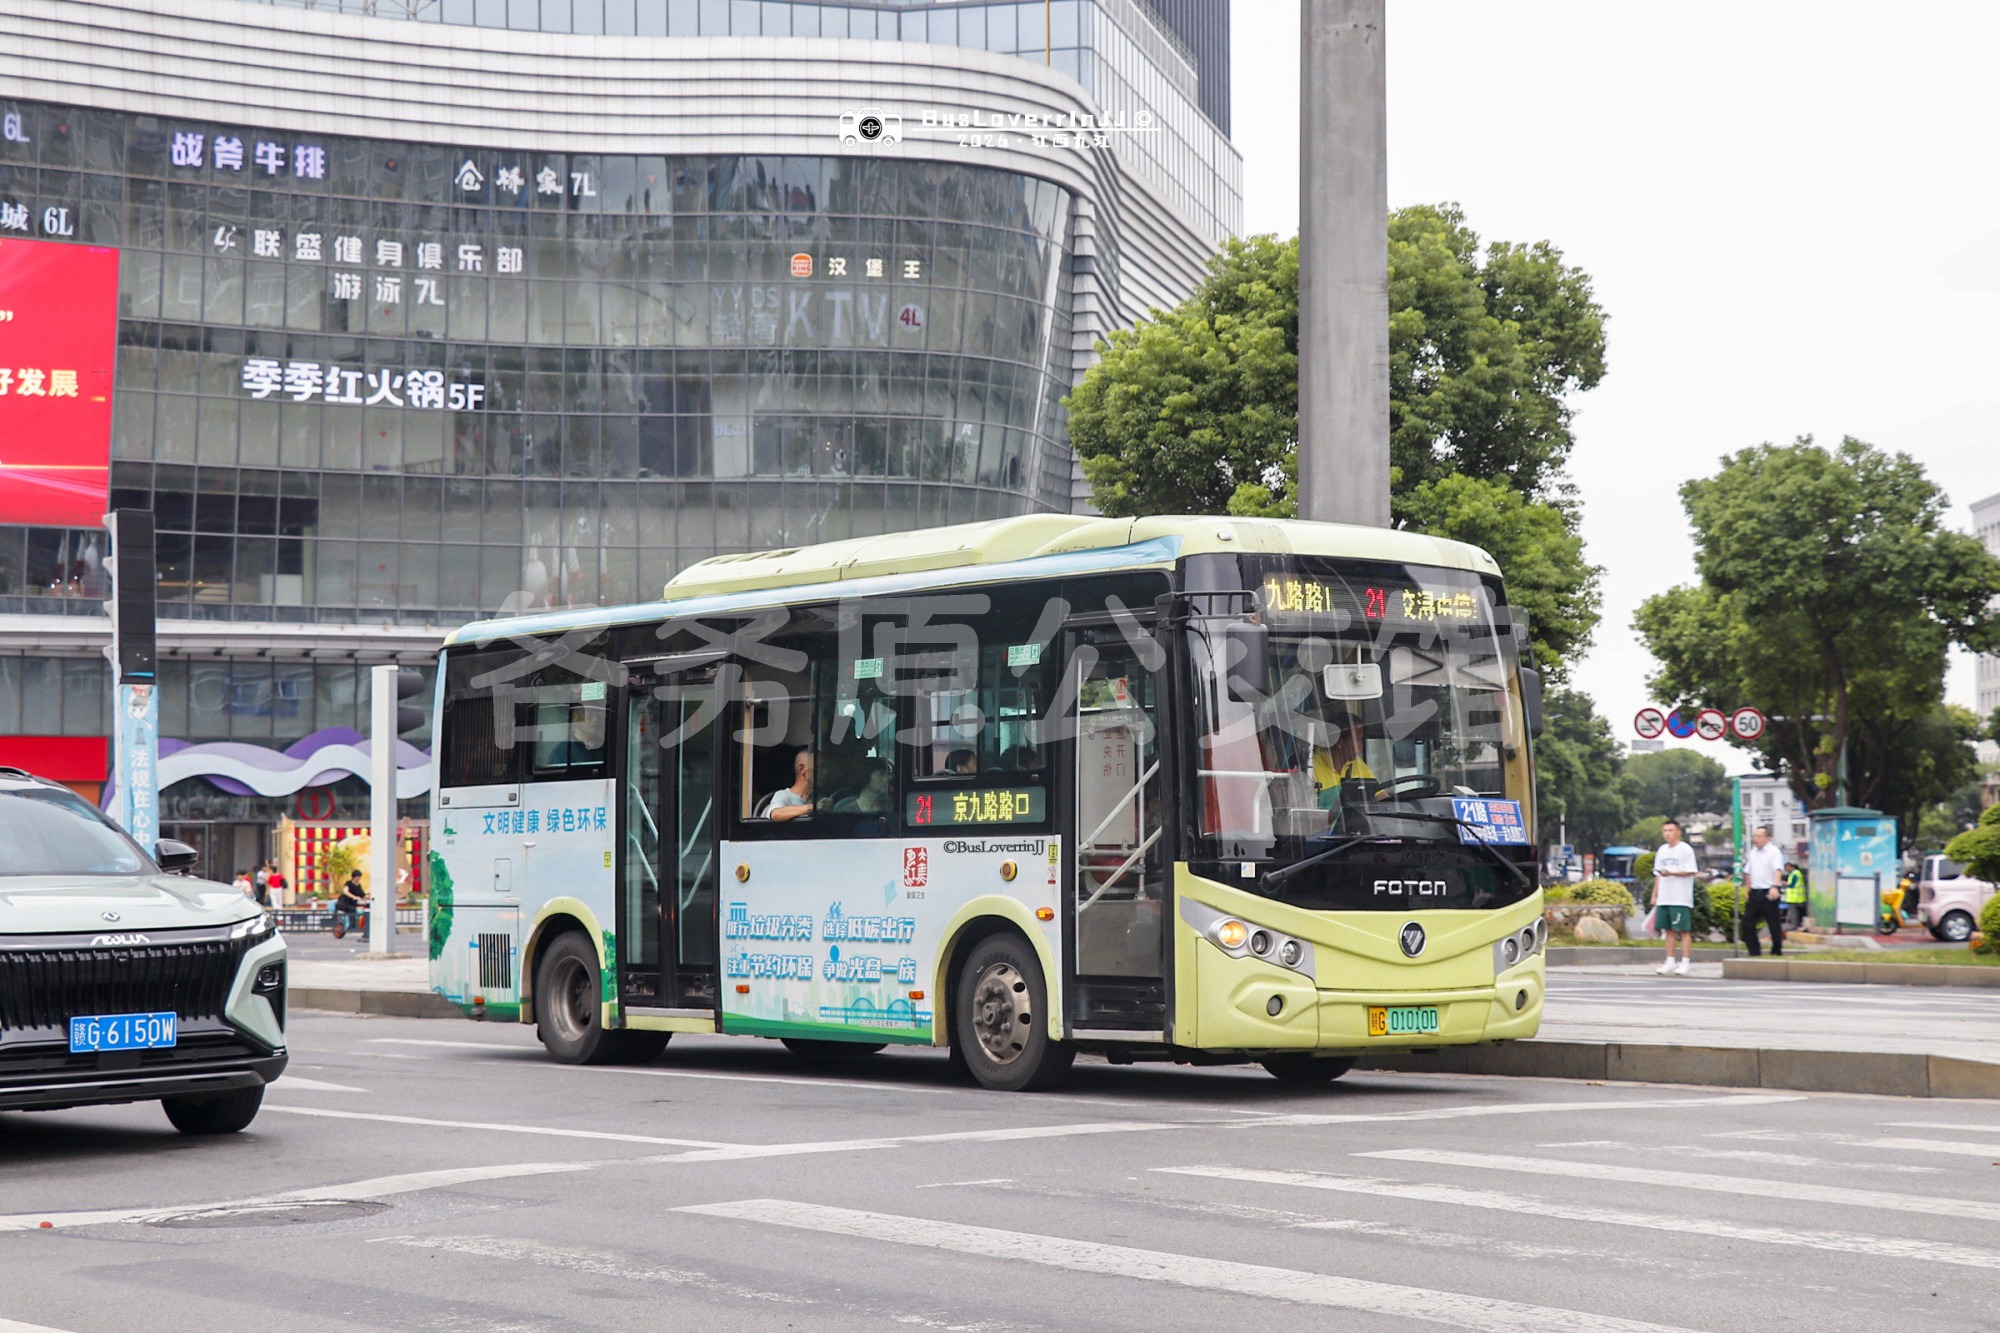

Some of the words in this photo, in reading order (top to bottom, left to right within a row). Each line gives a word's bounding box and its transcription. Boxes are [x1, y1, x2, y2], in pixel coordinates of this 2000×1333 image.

[4, 113, 31, 142] 6L
[171, 131, 325, 179] 战斧牛排
[0, 202, 29, 231] 城
[44, 207, 73, 235] 6L
[254, 229, 523, 273] 联盛健身俱乐部
[828, 257, 920, 279] 汉堡王
[789, 289, 888, 339] KTV
[899, 308, 921, 327] 4L
[1365, 588, 1386, 618] 21
[1739, 716, 1759, 732] 50
[131, 750, 150, 846] 法规在心中
[915, 794, 933, 824] 21
[953, 789, 1030, 822] 京九路路口
[483, 810, 540, 835] 文明健康
[547, 807, 607, 833] 绿色环保
[1373, 880, 1447, 896] FOTON
[726, 915, 813, 941] 推行垃圾分类
[823, 916, 915, 943] 选择低碳出行
[727, 954, 813, 980] 注重节约环保
[823, 955, 917, 984] 争做光盘一族
[1391, 1009, 1438, 1034] 01010D
